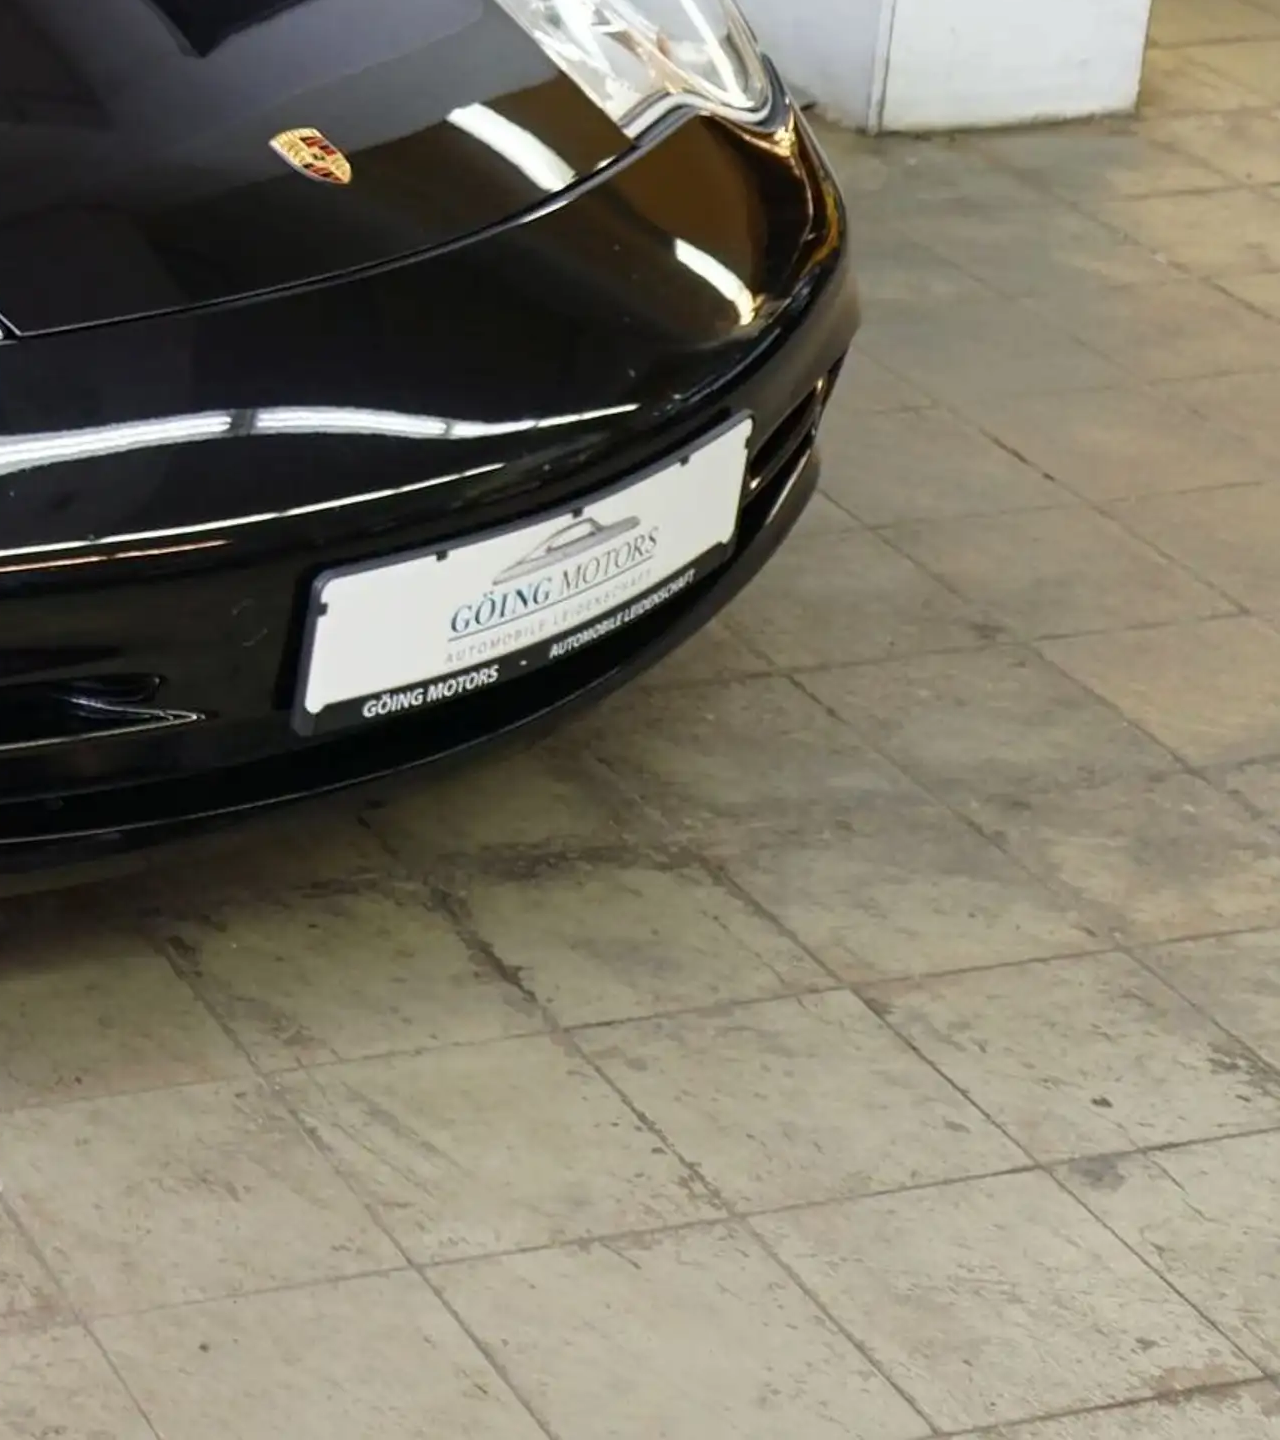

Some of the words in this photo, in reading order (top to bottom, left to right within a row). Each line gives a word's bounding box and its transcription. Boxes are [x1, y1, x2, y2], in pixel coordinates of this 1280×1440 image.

[444, 620, 546, 664] AUTOMOBILE
[552, 569, 653, 626] LEIDENSCHAFT
[450, 577, 553, 634] GÖING
[559, 526, 660, 595] MOTORS
[361, 689, 425, 718] GÖING
[426, 664, 500, 702] MOTORS
[548, 612, 626, 659] AUTOMOBILE
[623, 568, 697, 623] LEIDENSCHAFT
